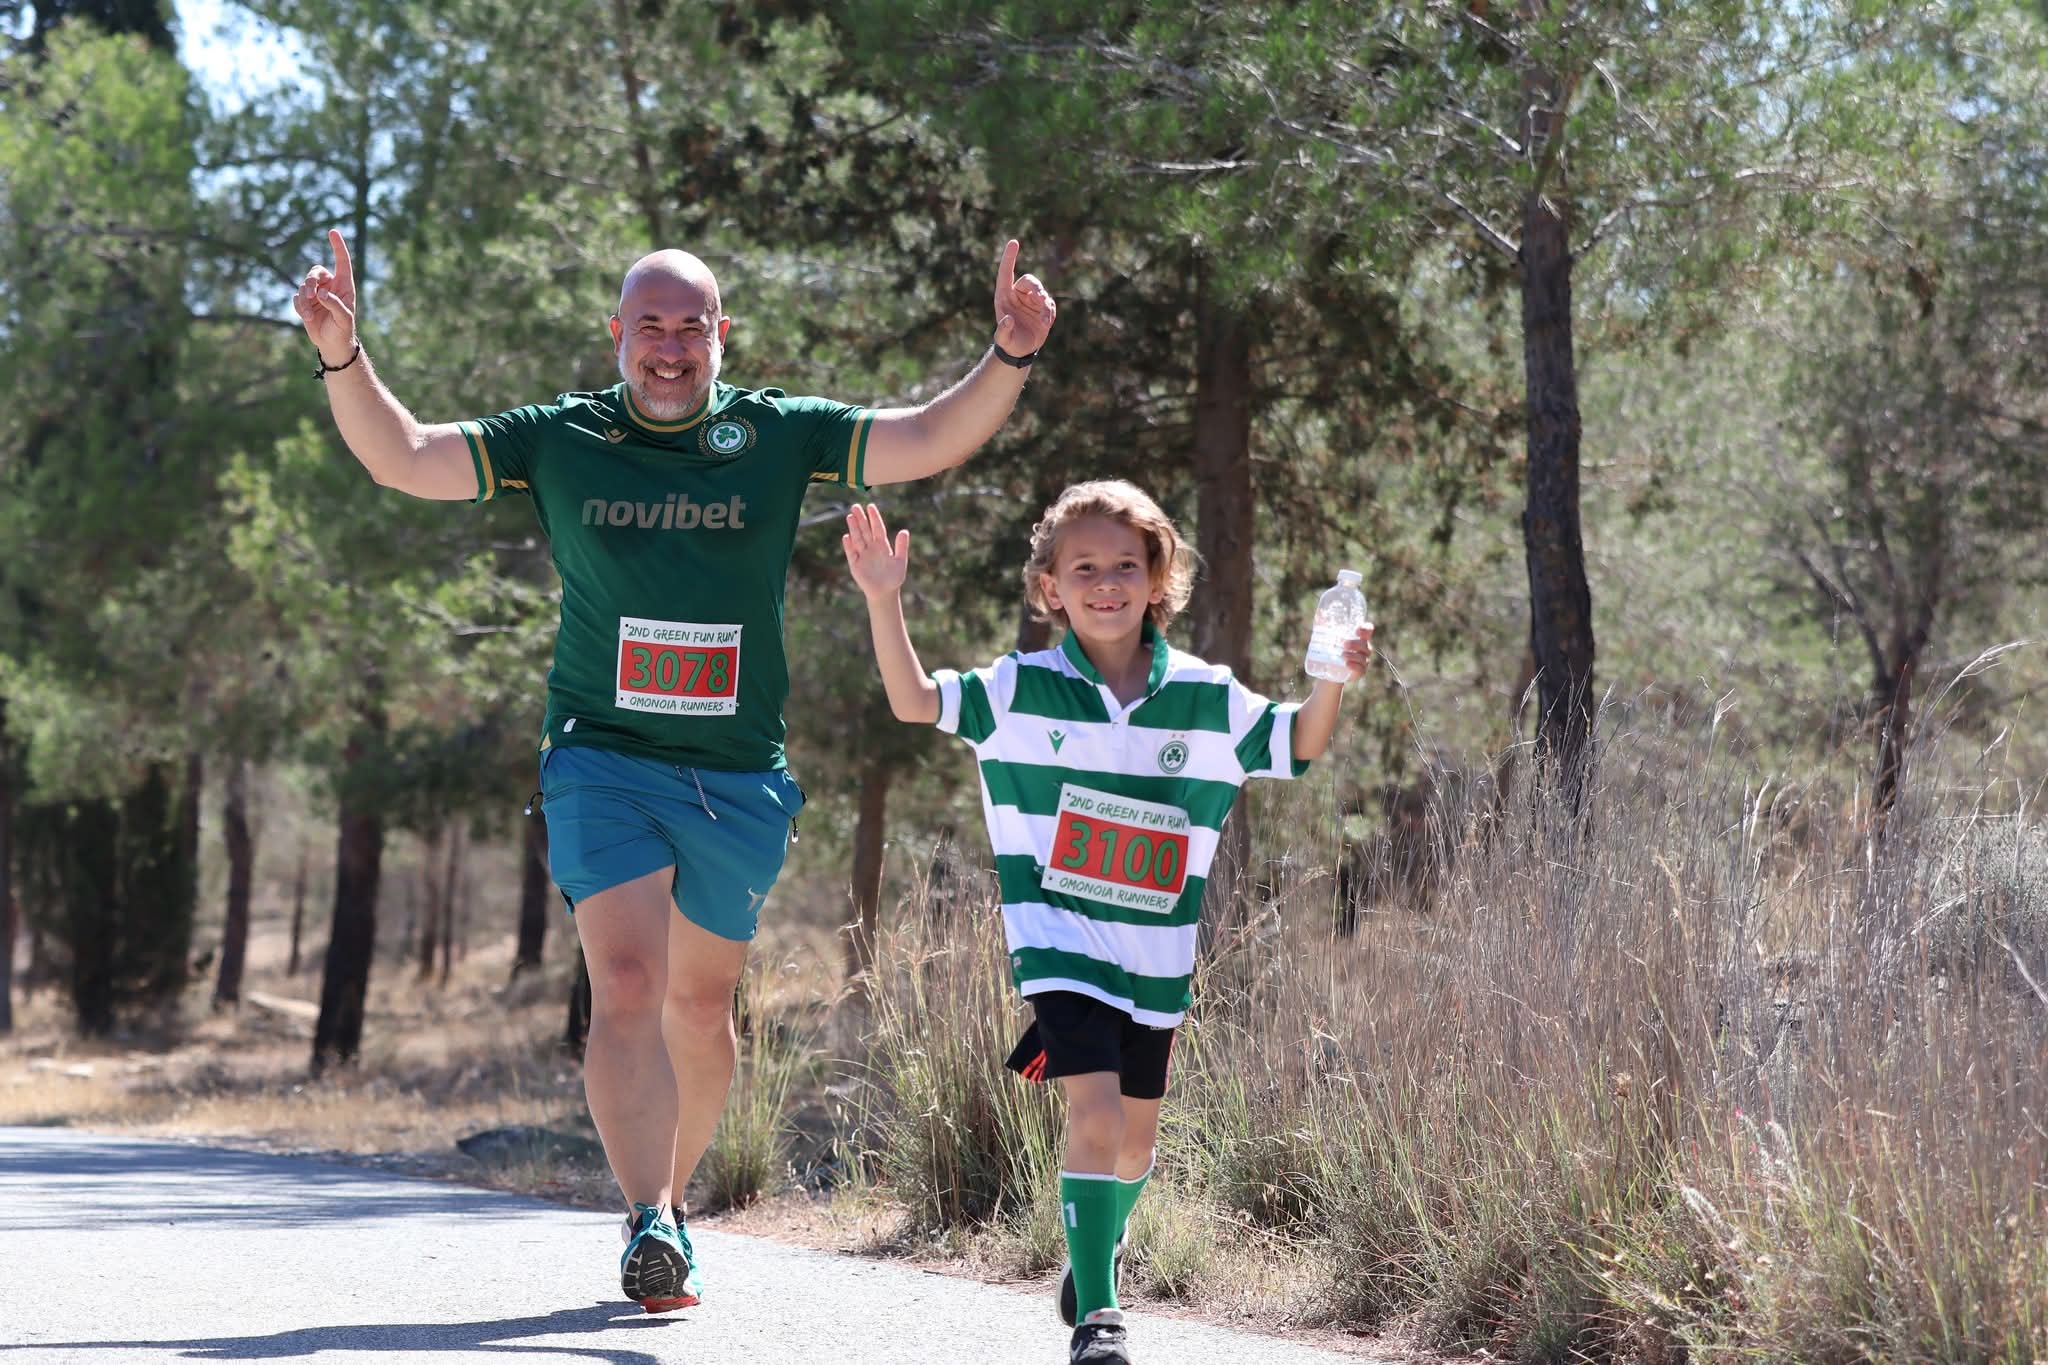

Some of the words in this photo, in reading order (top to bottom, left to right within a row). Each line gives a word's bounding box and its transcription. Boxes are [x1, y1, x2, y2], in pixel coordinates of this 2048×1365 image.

[582, 493, 746, 529] novibet
[627, 626, 650, 638] 2ND
[653, 628, 690, 641] GREEN
[693, 631, 714, 643] FUN
[717, 631, 734, 643] RUN
[628, 647, 729, 693] 3078
[629, 696, 677, 709] OMONOIA
[680, 699, 724, 712] RUNNERS
[1068, 795, 1094, 810] 2ND
[1096, 802, 1139, 819] GREEN
[1142, 811, 1166, 825] FUN
[1167, 815, 1186, 830] RUN
[1062, 820, 1179, 887] 3100
[1059, 877, 1113, 897] OMONOIA
[1117, 889, 1169, 909] RUNNERS
